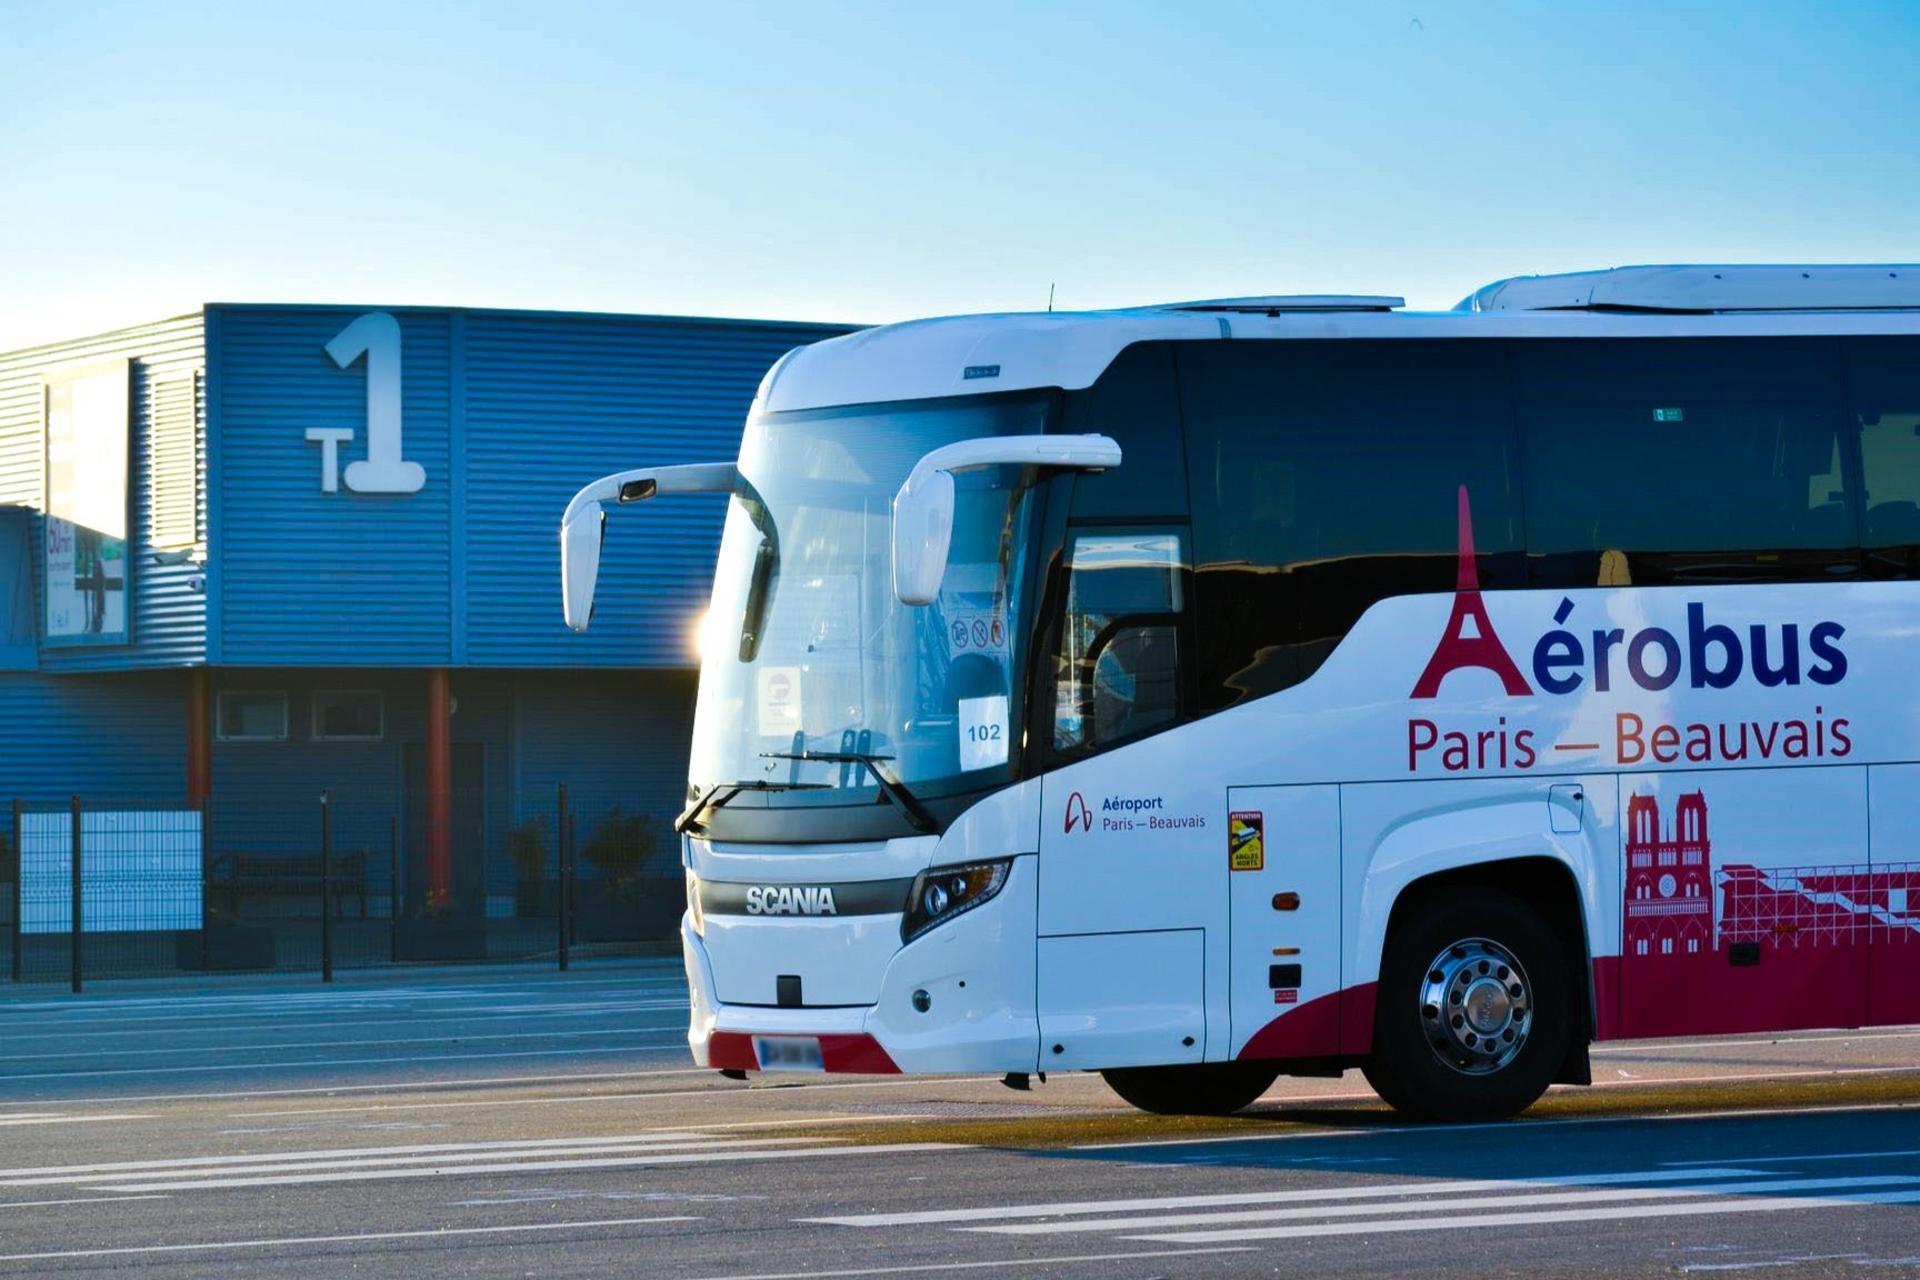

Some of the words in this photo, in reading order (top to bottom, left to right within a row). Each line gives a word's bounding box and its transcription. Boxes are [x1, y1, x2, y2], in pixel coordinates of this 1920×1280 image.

[1409, 484, 1848, 699] Aérobus
[968, 724, 1001, 742] 102
[1408, 717, 1536, 771] Paris
[1616, 706, 1851, 764] Beauvais
[1102, 796, 1163, 814] Aéroport
[1103, 817, 1134, 831] Paris
[1149, 815, 1206, 829] Beauvais
[746, 886, 837, 915] SCANIA
